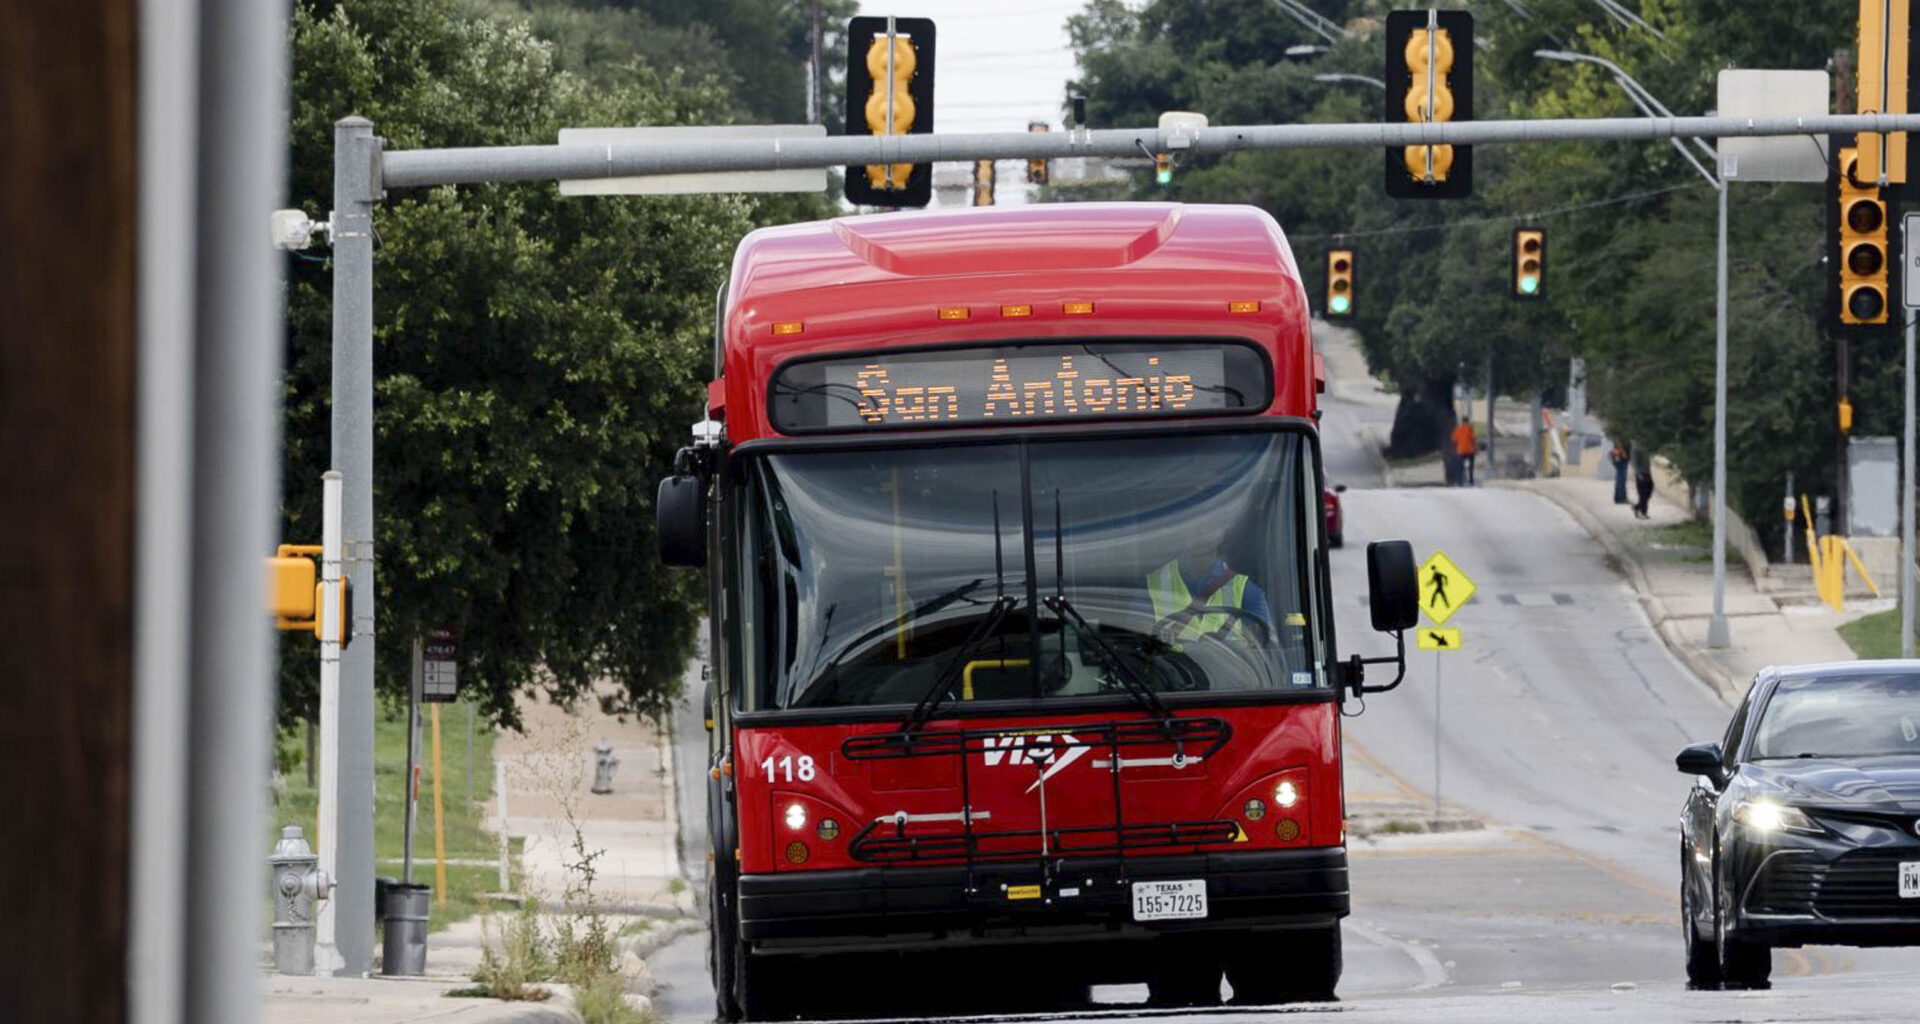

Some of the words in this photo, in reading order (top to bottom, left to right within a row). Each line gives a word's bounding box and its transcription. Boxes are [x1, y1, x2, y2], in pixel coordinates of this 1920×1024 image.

[856, 364, 958, 422] San
[983, 356, 1194, 416] Antonio
[761, 755, 815, 783] 118
[1155, 884, 1183, 892] TEXAS
